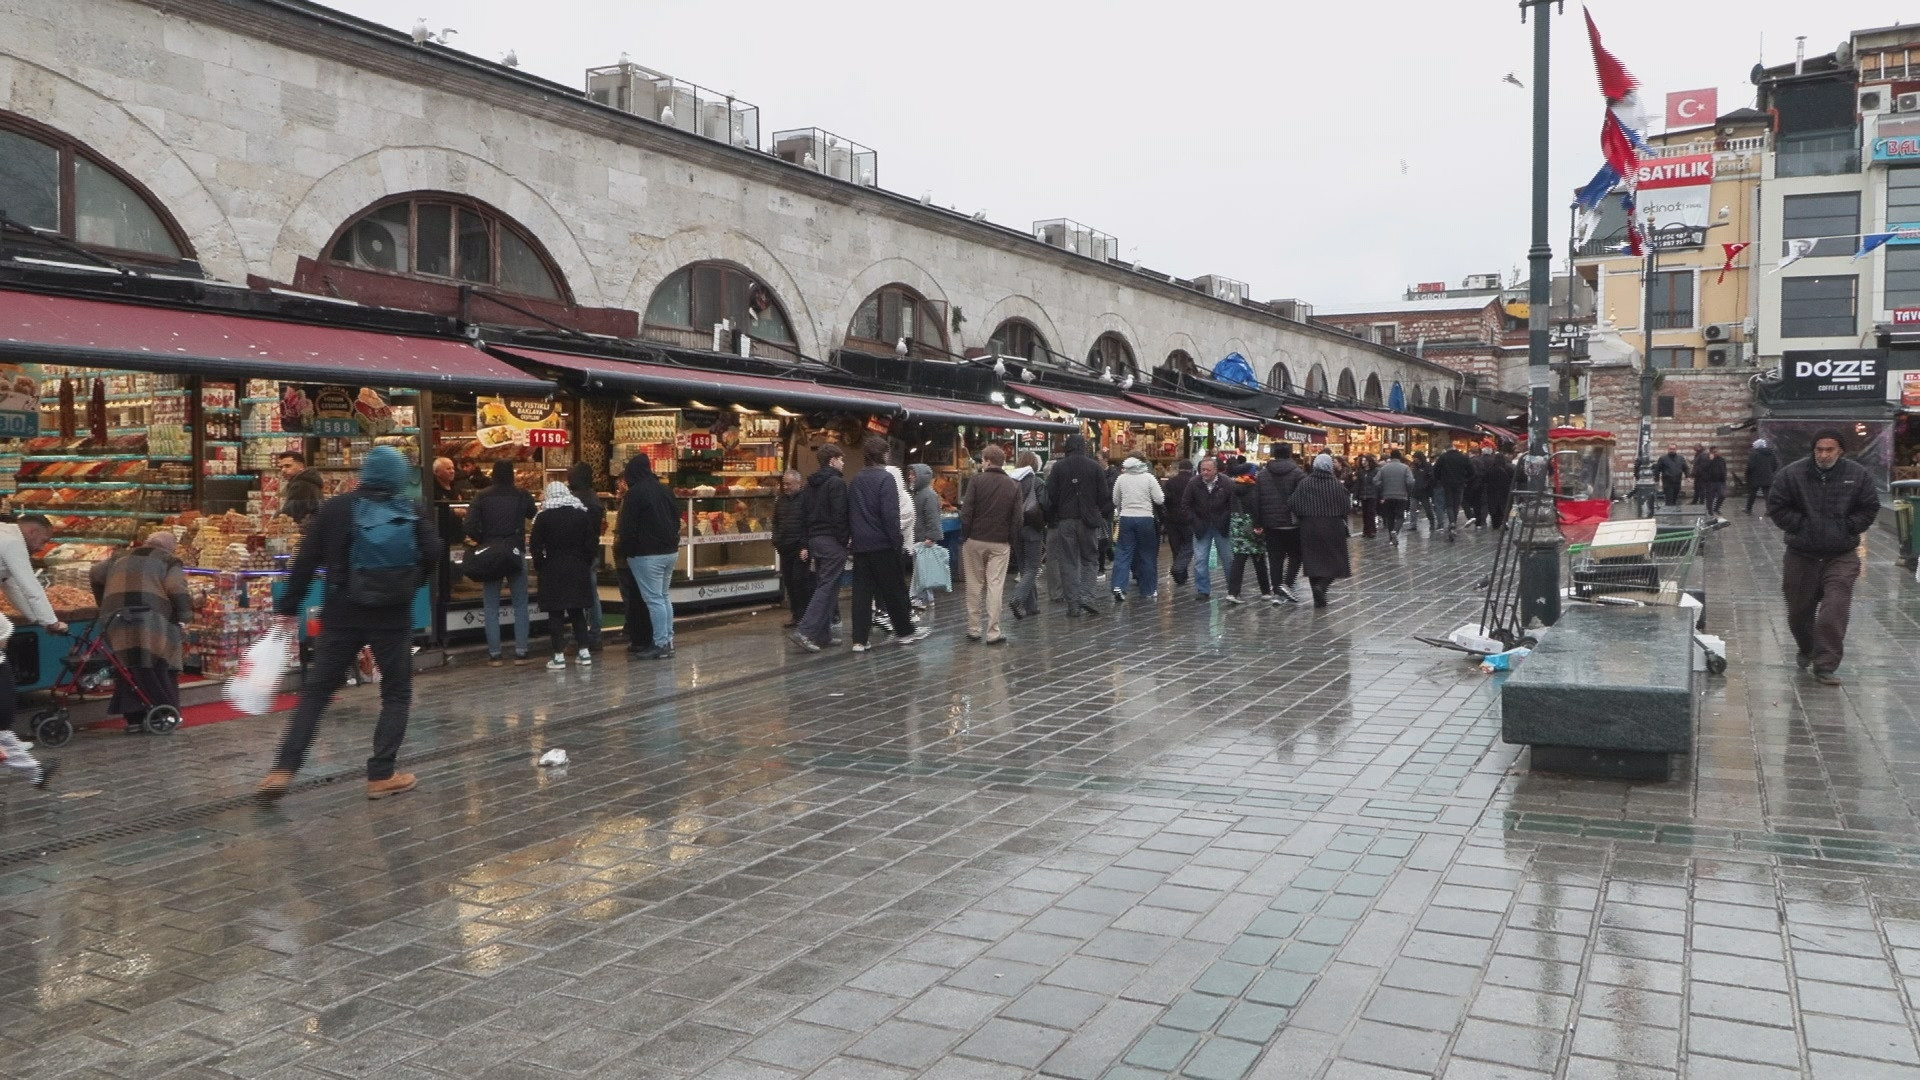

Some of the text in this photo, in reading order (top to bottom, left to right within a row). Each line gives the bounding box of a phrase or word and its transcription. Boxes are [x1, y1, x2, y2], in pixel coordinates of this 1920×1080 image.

[1886, 139, 1920, 156] BAL
[1640, 161, 1710, 182] SATILIK
[1895, 311, 1920, 322] TAV
